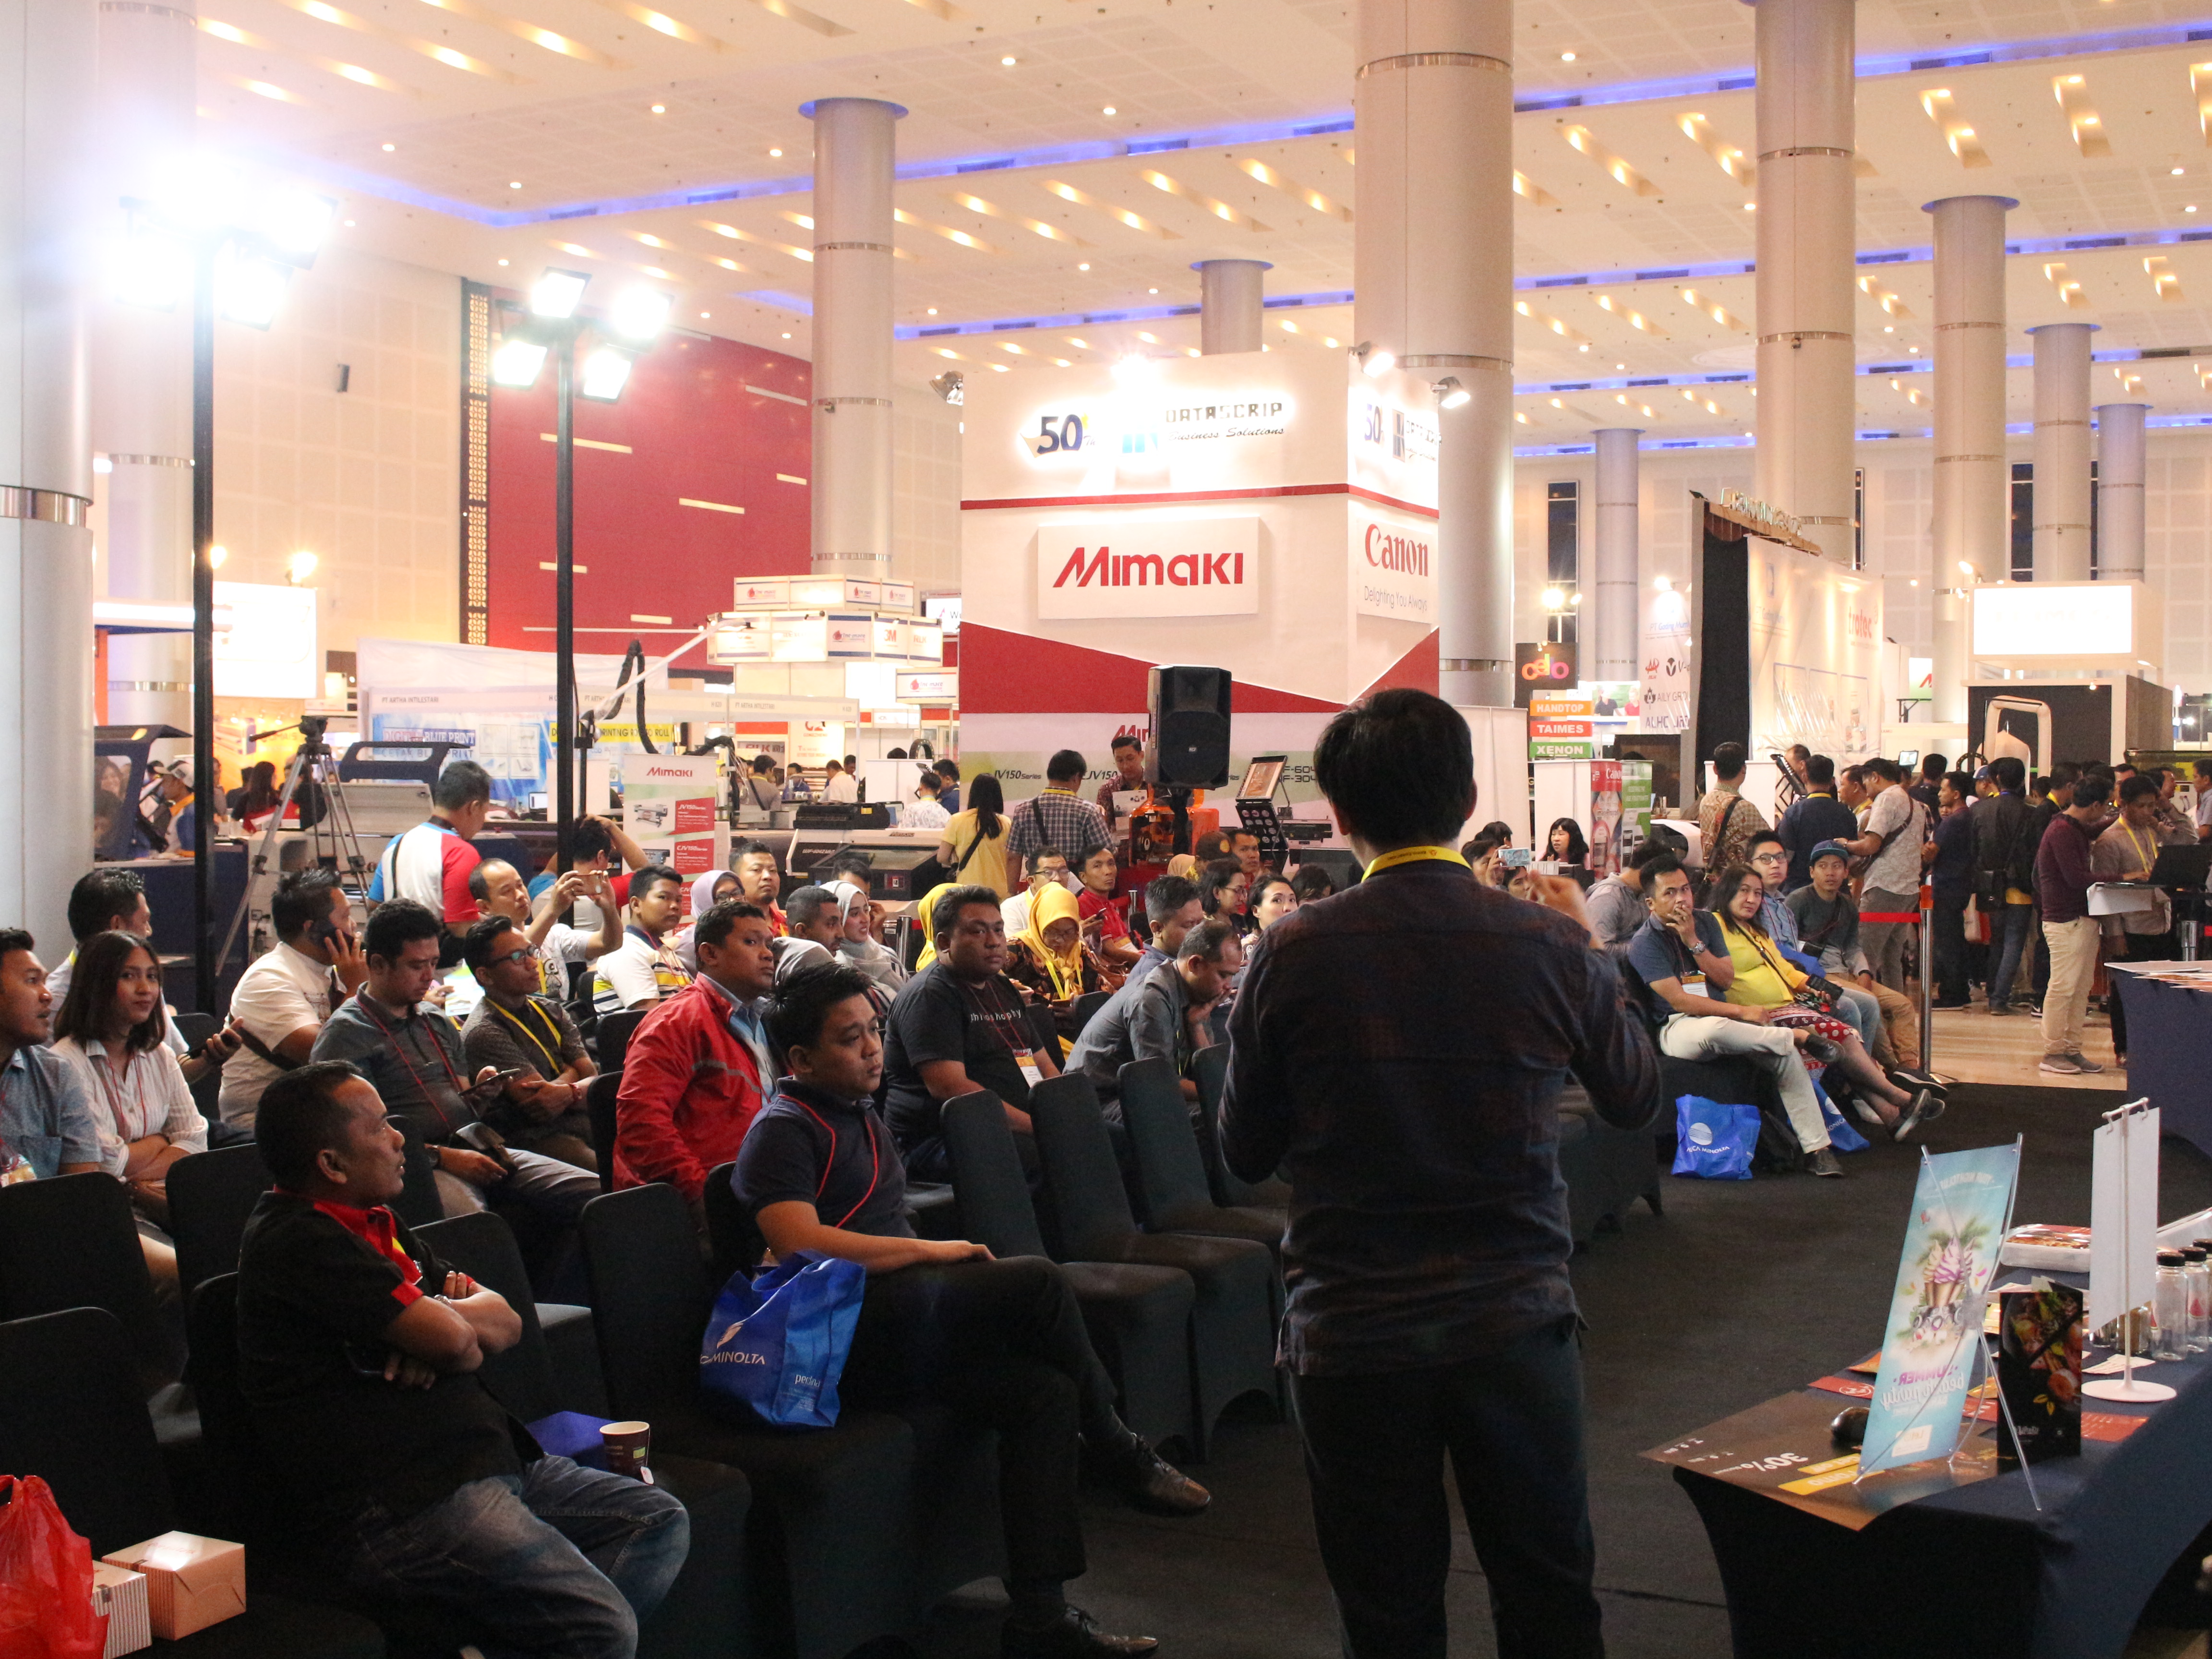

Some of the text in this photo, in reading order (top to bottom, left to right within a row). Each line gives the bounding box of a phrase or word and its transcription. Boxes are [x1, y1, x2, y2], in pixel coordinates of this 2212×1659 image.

[1166, 402, 1282, 422] DATASCRIP
[1036, 414, 1083, 454] 50
[1168, 426, 1285, 441] Business Solutions
[1365, 523, 1428, 577] Canon
[1052, 546, 1244, 588] Mimaki
[1364, 586, 1428, 614] Delighting You Always
[1848, 606, 1872, 639] trotec
[884, 629, 897, 642] 3M
[1537, 704, 1584, 713] HANDTOP
[655, 729, 670, 737] ROLL
[1537, 724, 1584, 733] TAIMES
[425, 730, 447, 743] BLUE
[448, 732, 475, 744] PRINT
[1536, 745, 1583, 754] XENON
[646, 767, 693, 777] Mimaki
[1605, 768, 1622, 780] Cano
[1702, 1145, 1730, 1154] MINOLTA
[711, 1351, 766, 1365] MINOLTA
[1740, 1452, 1809, 1472] 30%
